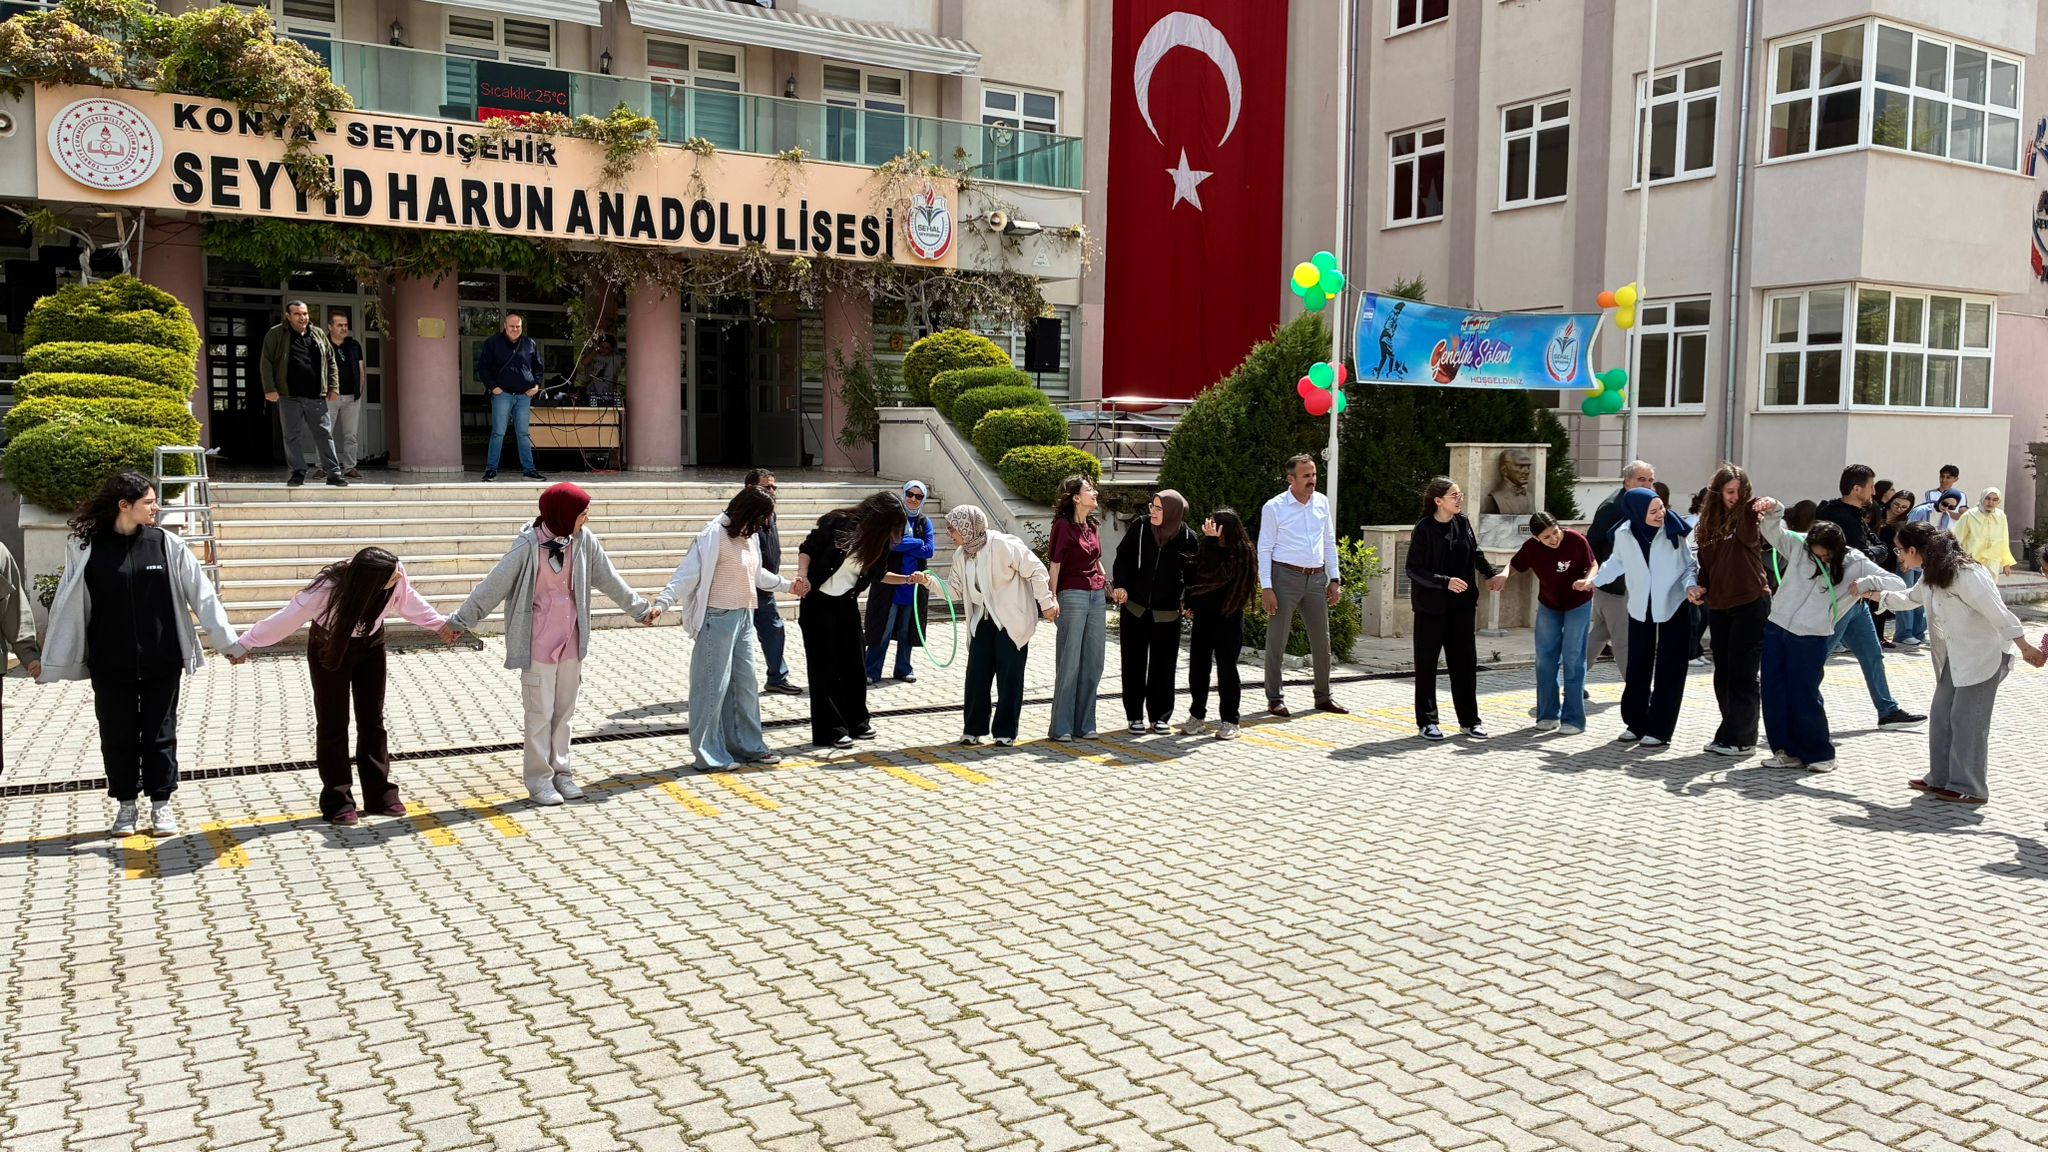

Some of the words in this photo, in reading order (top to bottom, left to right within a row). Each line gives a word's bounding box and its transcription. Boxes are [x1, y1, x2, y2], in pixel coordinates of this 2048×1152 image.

[481, 82, 531, 101] Sıcaklık
[535, 89, 567, 105] 25°C
[346, 121, 558, 166] SEYDİŞEHİR
[172, 151, 373, 218] SEYYİD
[387, 171, 555, 233] HARUN
[565, 189, 767, 246] ANADOLU
[777, 199, 894, 258] LİSESİ
[917, 224, 941, 234] SEHAL
[1430, 338, 1473, 380] Gençlik
[1474, 338, 1513, 368] Şöleni
